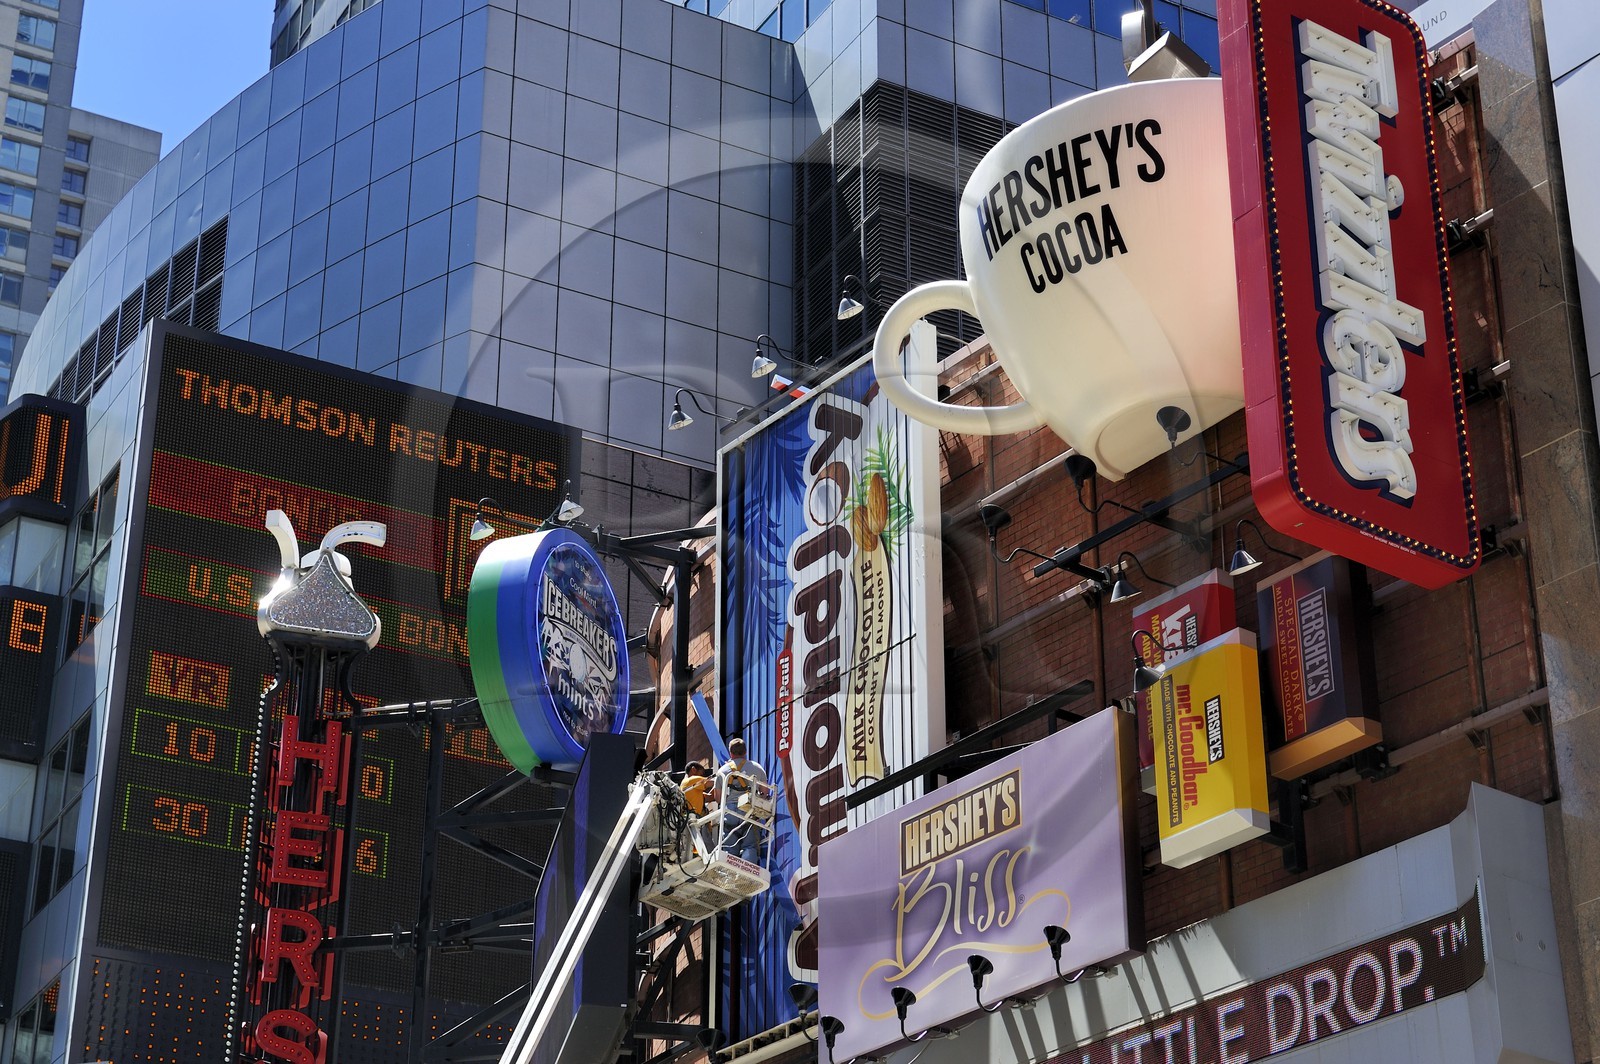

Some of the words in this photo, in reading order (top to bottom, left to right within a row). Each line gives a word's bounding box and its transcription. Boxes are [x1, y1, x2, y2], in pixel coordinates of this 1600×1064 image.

[976, 118, 1166, 262] HERSHEY'S
[1020, 203, 1128, 294] COCOA
[1298, 18, 1427, 500] Twizzlers
[176, 366, 377, 447] THOMSON
[389, 423, 558, 491] REUTERS
[854, 558, 874, 696] CHOCOLATE
[1275, 586, 1284, 629] MILDLY
[1284, 596, 1297, 662] SPECIAL
[868, 664, 882, 745] COCONUT
[875, 569, 884, 645] ALMONDS
[1279, 630, 1288, 666] SWEET
[1300, 592, 1331, 698] HERSHEY'S
[558, 673, 594, 721] mints
[778, 655, 790, 698] Paul
[1163, 679, 1171, 700] MADE
[1283, 667, 1294, 736] CHOCOLATE
[778, 700, 791, 752] Peter
[851, 698, 869, 762] MILK
[1164, 700, 1172, 722] WITH
[1206, 698, 1223, 763] HERSHEY'S
[162, 721, 216, 762] 10
[1166, 722, 1176, 772] CHOCOLATE
[1169, 773, 1177, 787] AND
[1170, 788, 1180, 824] PEANUTS
[152, 796, 209, 838] 30
[905, 776, 1017, 871] HERSHEY'S
[726, 854, 744, 864] NORTH
[744, 861, 761, 872] SHORE
[726, 859, 741, 868] NEON
[884, 845, 1031, 984] Bliss
